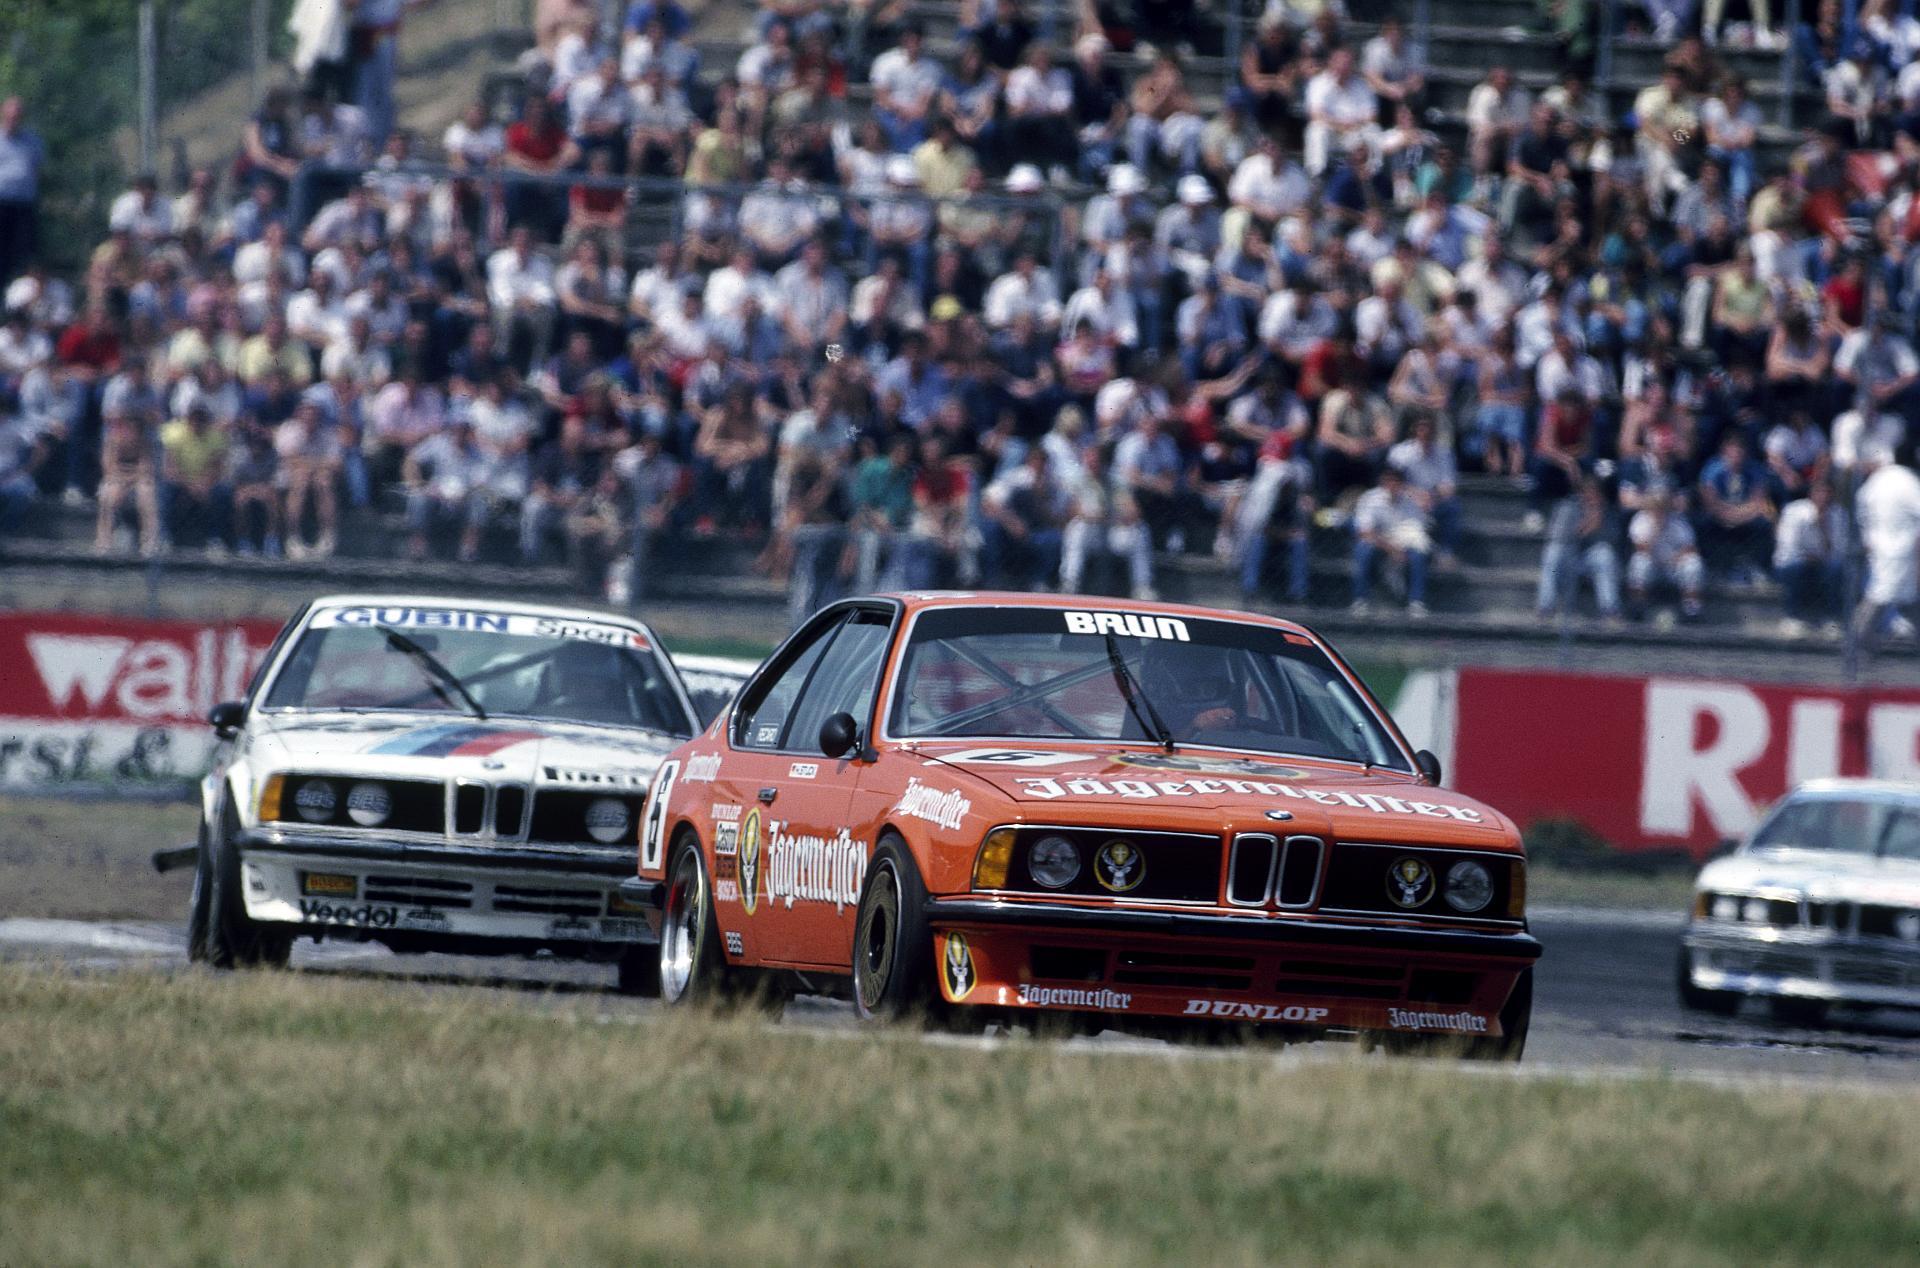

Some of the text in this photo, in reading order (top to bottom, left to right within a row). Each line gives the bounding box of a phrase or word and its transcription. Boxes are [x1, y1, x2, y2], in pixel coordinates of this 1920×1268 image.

[334, 608, 509, 632] GUBIN
[1064, 612, 1191, 641] BRUN
[300, 899, 398, 926] Veedol
[1183, 999, 1329, 1022] DUNLOP
